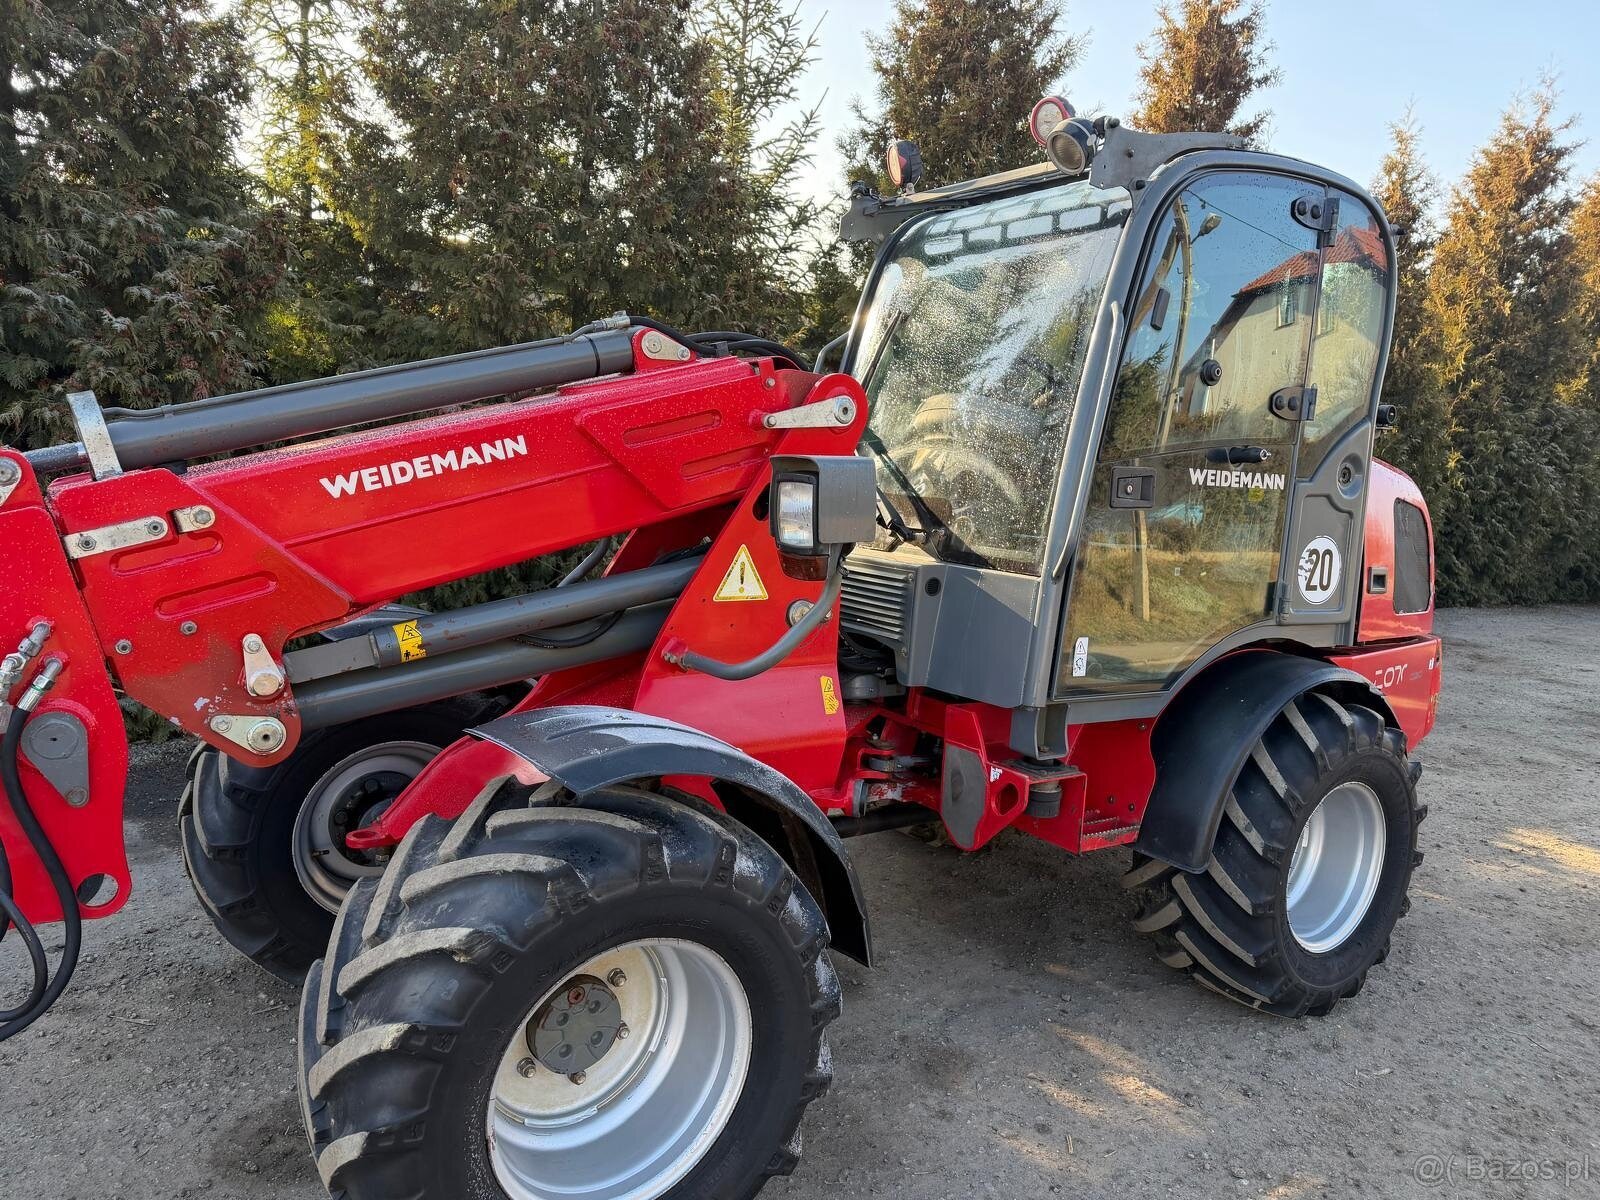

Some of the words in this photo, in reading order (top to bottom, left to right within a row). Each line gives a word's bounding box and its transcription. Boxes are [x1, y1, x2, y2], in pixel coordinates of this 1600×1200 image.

[318, 434, 528, 499] WEIDEMANN
[1188, 467, 1286, 490] WEIDEMANN
[1305, 548, 1334, 592] 20
